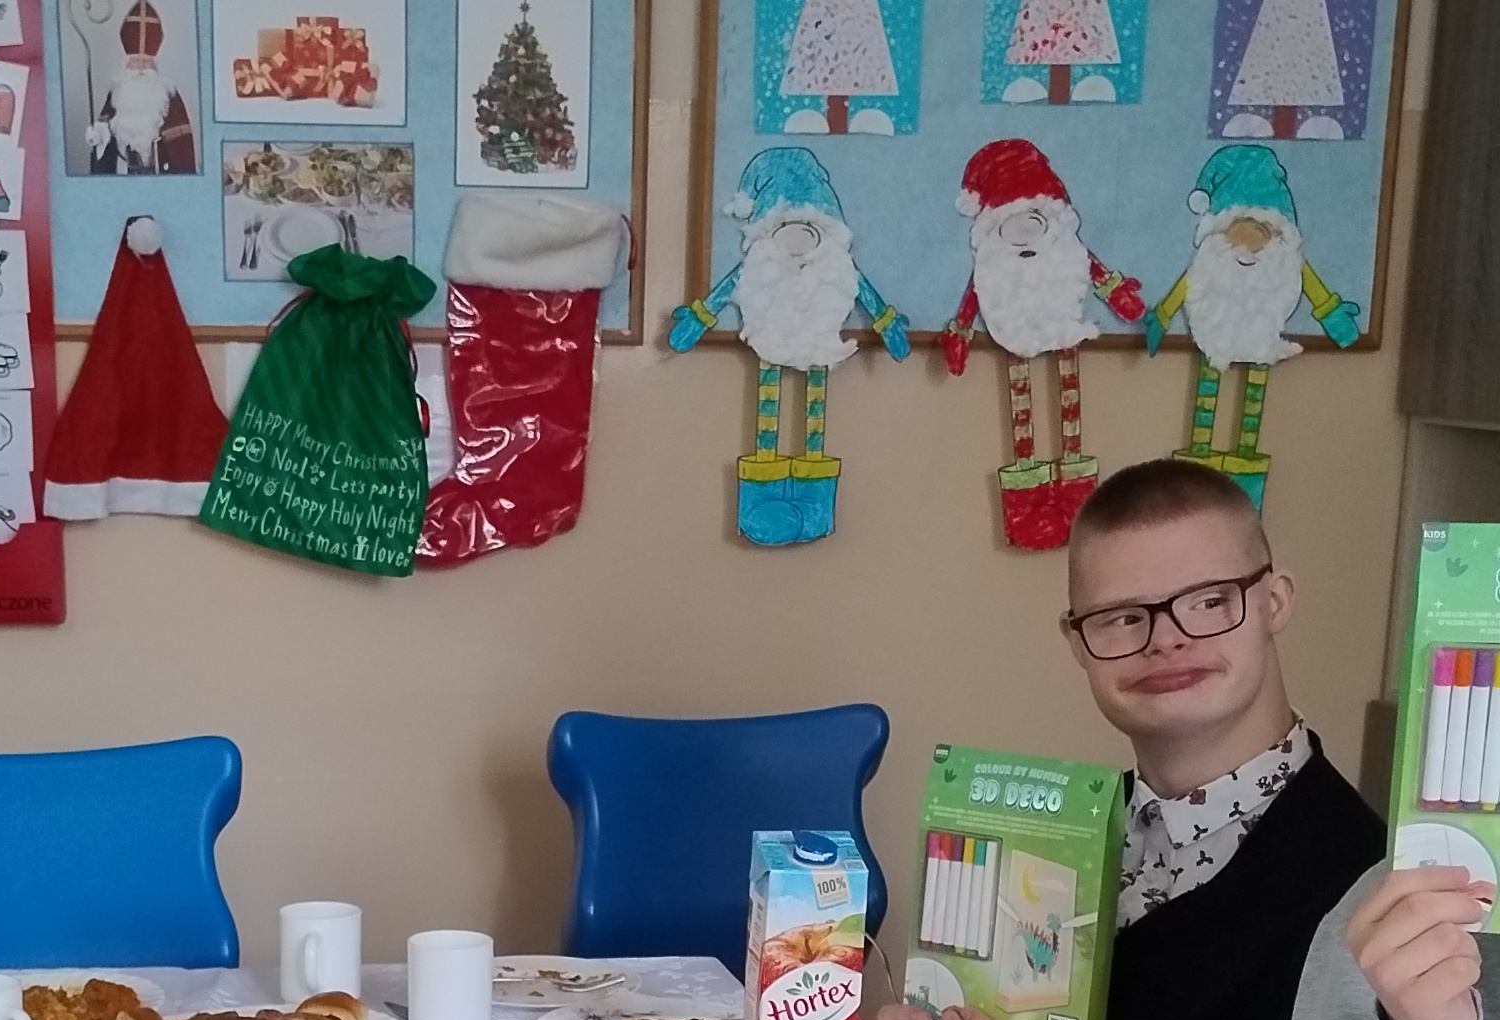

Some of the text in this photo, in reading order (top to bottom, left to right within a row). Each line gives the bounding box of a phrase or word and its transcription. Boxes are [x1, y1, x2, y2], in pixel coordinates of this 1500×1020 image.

[240, 403, 292, 441] HAPPY
[292, 424, 331, 464] Merry
[332, 441, 409, 472] Christmas
[271, 447, 308, 479] Noel
[220, 455, 416, 538] Enjoy Happy Holy Night
[330, 470, 421, 508] Let's party!
[211, 487, 258, 532] Merry
[261, 507, 349, 558] Christmas
[1423, 530, 1447, 539] KIDS
[974, 762, 1012, 776] COLOUR
[1013, 765, 1029, 777] BY
[969, 777, 1064, 817] 3D DECO
[816, 876, 847, 896] 100%
